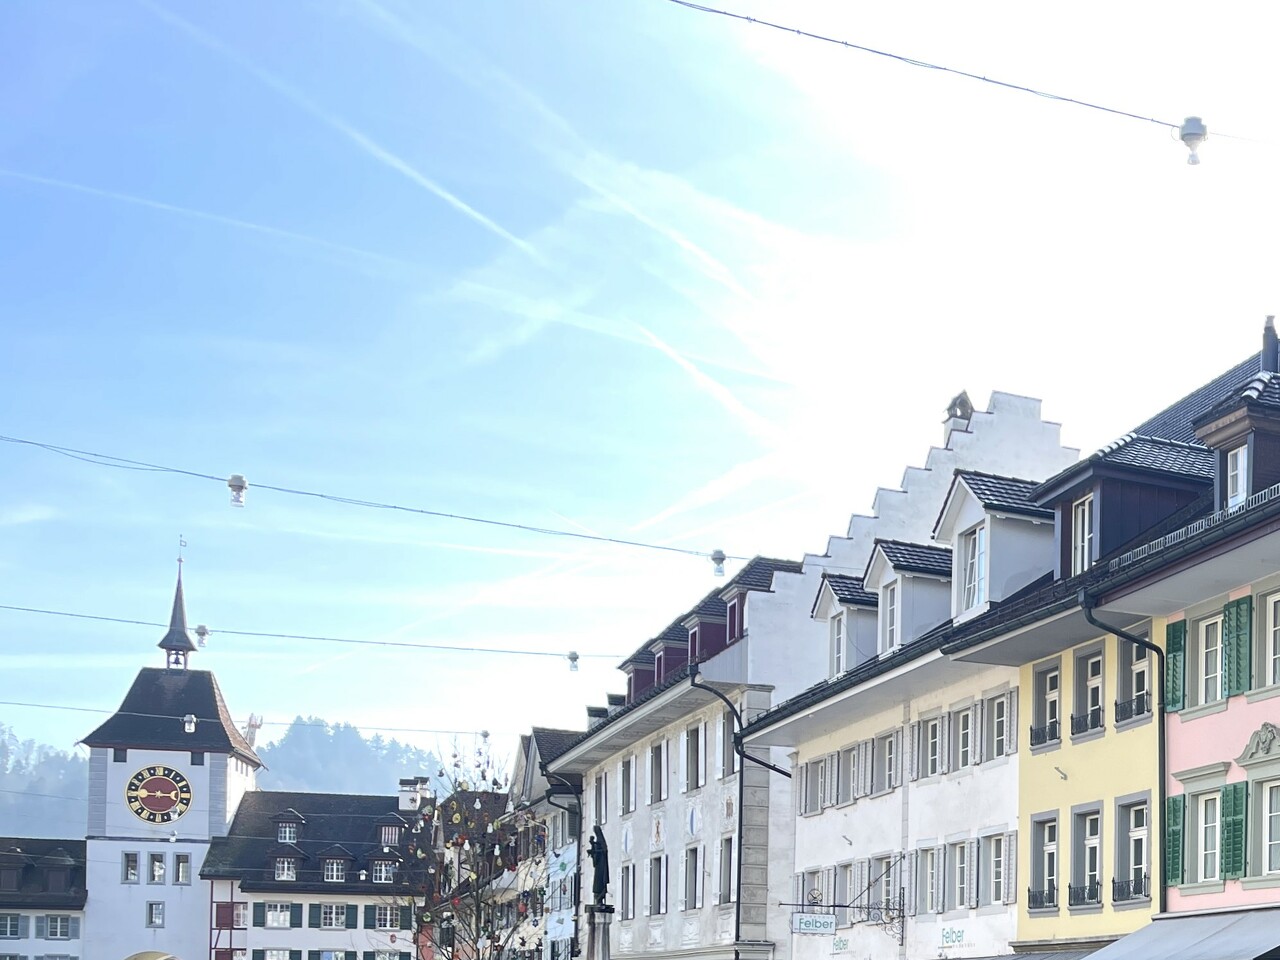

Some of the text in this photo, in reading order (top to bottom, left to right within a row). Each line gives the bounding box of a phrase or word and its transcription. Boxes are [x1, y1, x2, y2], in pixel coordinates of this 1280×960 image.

[799, 917, 833, 931] Felber
[832, 937, 849, 950] Felber
[941, 928, 965, 945] Felber
